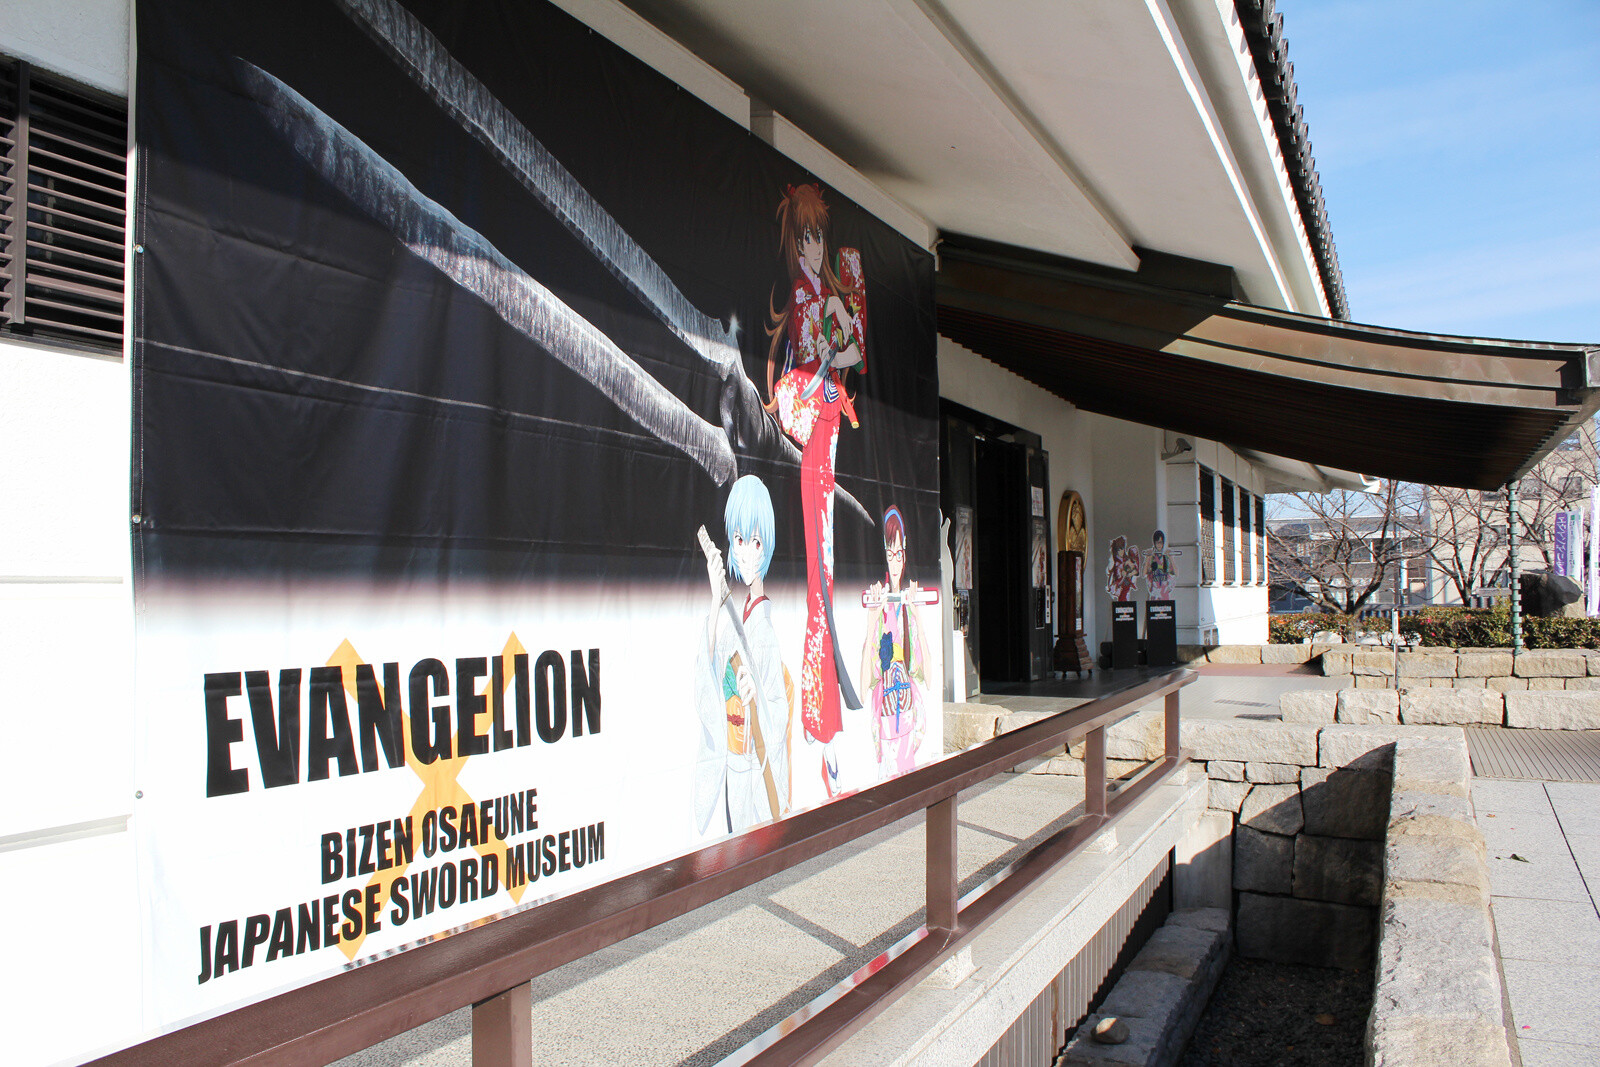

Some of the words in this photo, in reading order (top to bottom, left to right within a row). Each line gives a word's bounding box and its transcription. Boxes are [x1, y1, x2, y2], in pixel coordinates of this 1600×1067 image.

[203, 648, 601, 798] EVANGELION
[198, 884, 381, 985] JAPANESE
[390, 853, 499, 926] SWORD
[505, 822, 605, 891] MUSEUM
[320, 816, 413, 885] BIZEN
[421, 788, 538, 859] OSAFUNE
